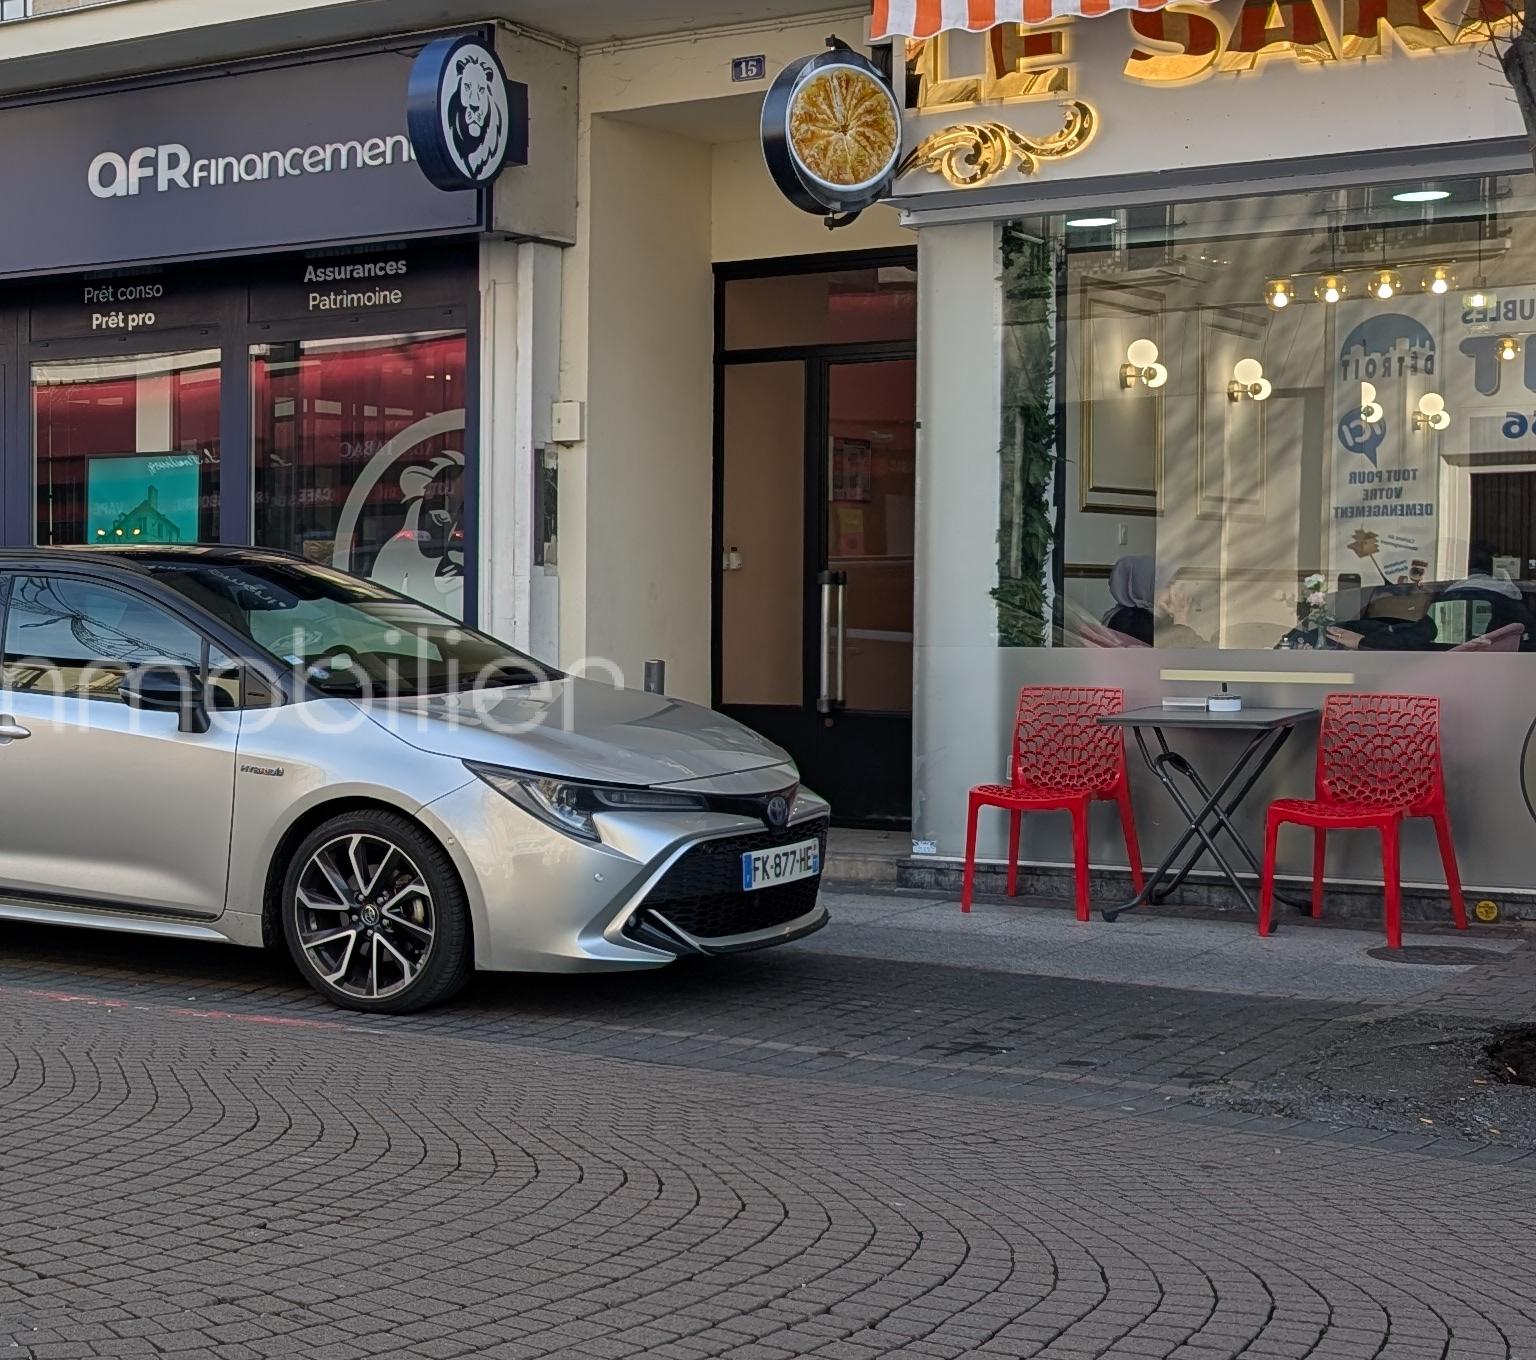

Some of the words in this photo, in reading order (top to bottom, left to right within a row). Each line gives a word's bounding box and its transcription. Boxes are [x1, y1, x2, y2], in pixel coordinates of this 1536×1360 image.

[739, 59, 758, 78] 15
[917, 15, 1070, 109] LE
[304, 259, 407, 283] Assurances
[84, 285, 114, 304] Prêt
[117, 284, 163, 301] conso
[309, 286, 402, 311] Patrimoine
[92, 311, 124, 330] Prêt
[128, 312, 156, 331] pro
[752, 845, 813, 883] FK-877-HE
